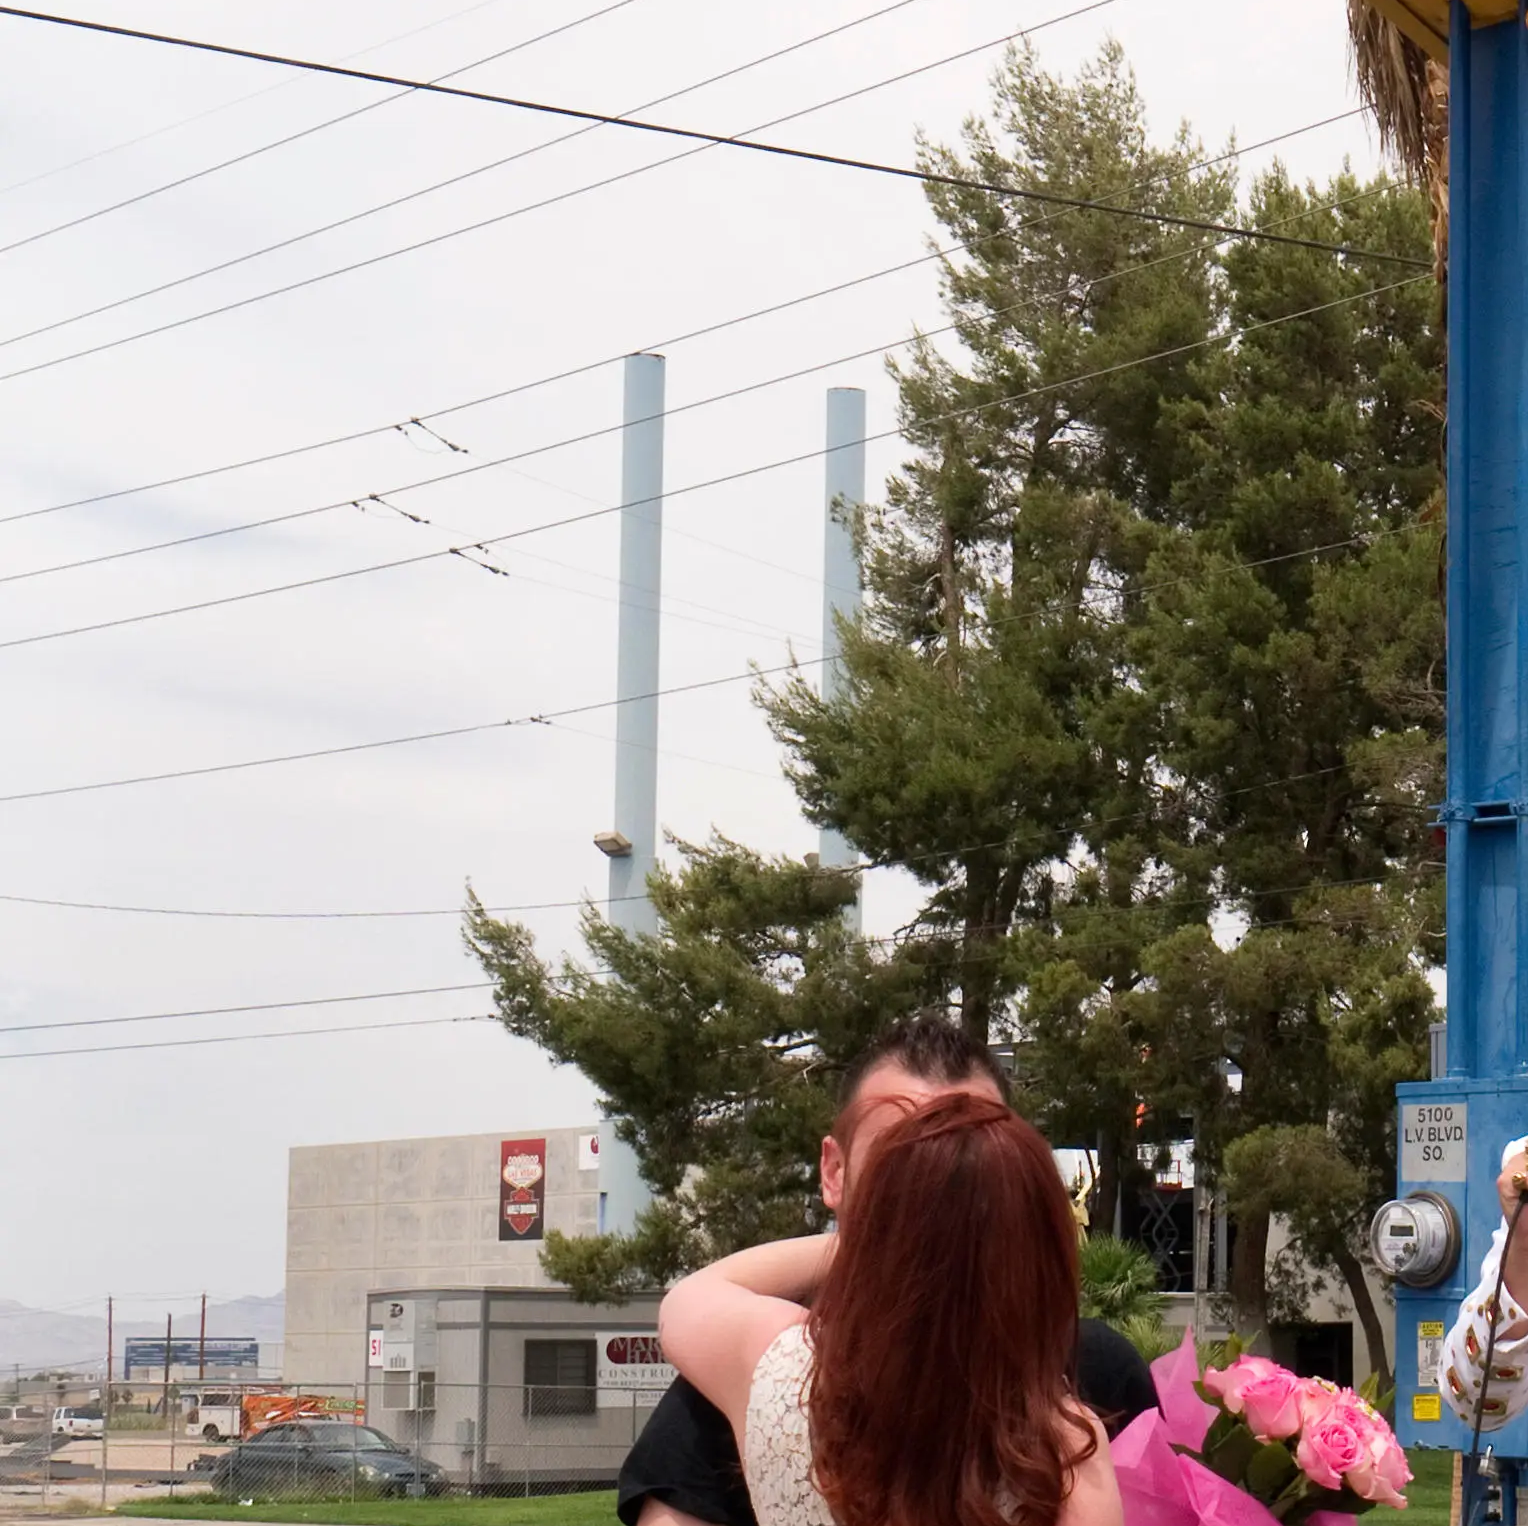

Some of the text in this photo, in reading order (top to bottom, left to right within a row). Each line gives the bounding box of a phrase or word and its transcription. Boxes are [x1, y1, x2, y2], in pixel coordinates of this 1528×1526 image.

[1418, 1107, 1453, 1123] 5100
[1423, 1145, 1444, 1161] SO.
[598, 1368, 678, 1378] CONSTRUC
